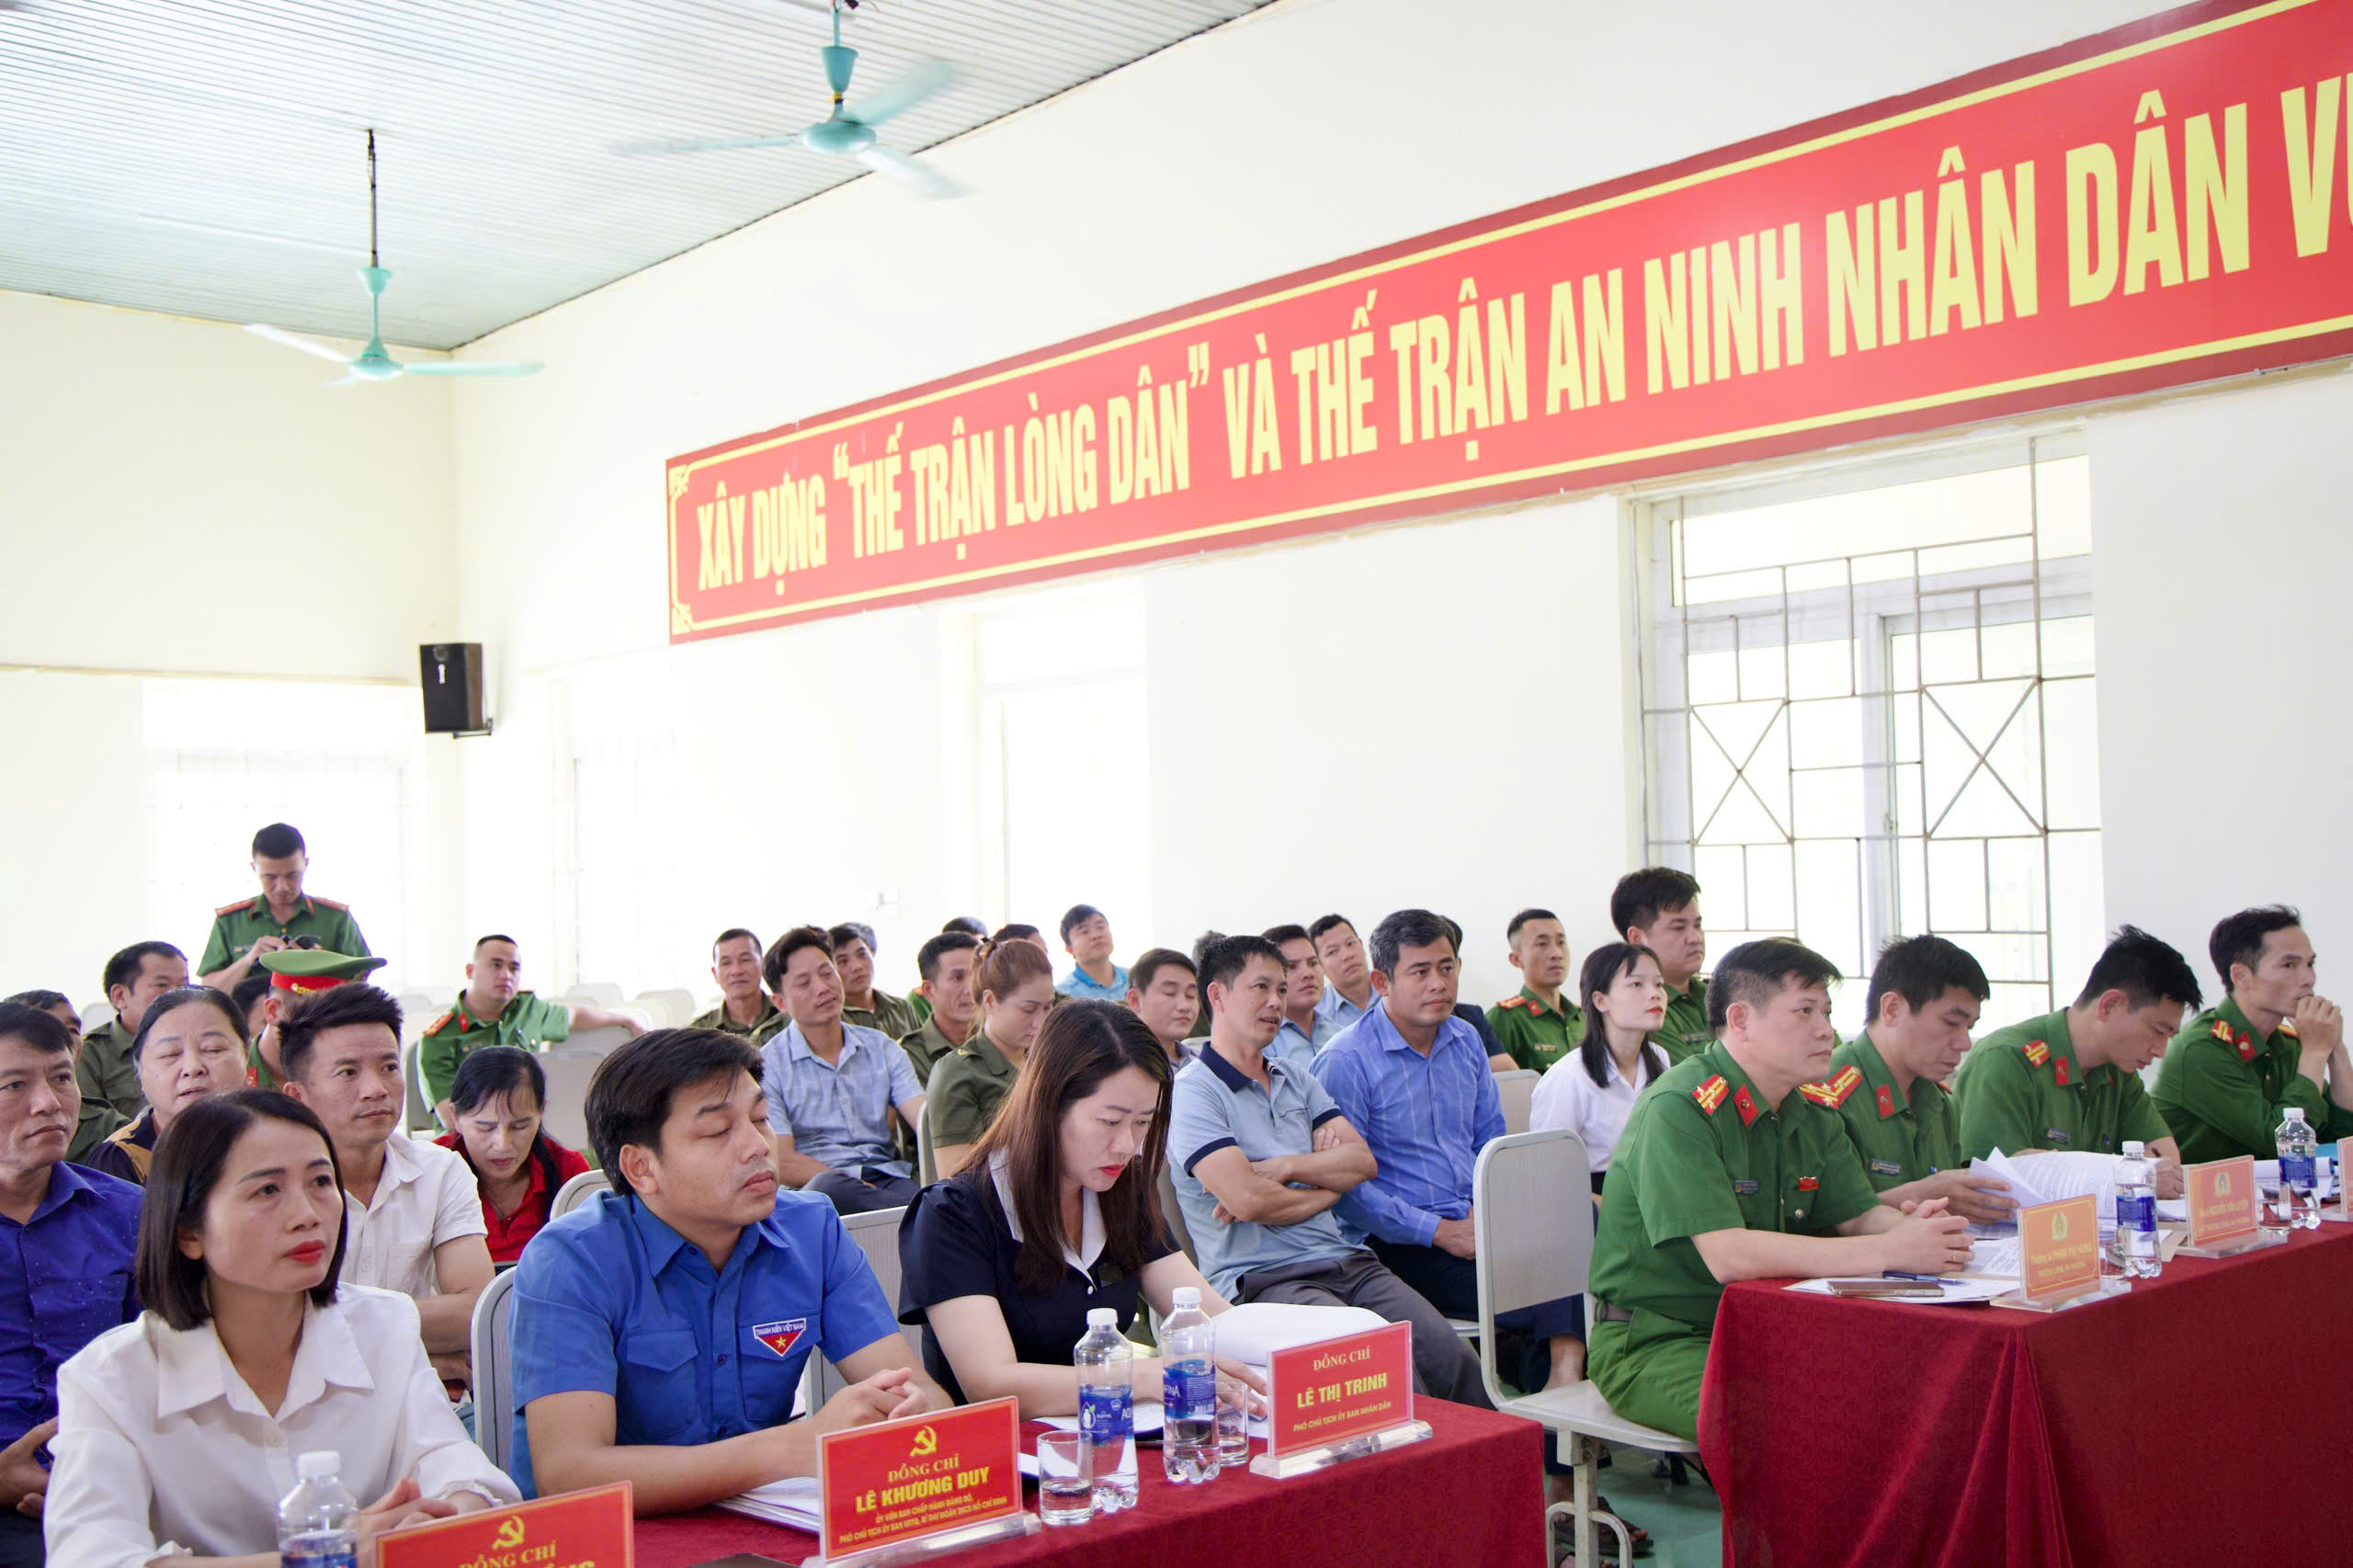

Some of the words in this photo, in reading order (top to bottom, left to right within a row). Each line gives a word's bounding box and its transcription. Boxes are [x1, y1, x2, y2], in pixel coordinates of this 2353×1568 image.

[697, 481, 745, 591] XÂY
[752, 469, 827, 596] DỰNG
[910, 416, 996, 561] TRẬN
[1005, 392, 1098, 527] LÒNG
[1222, 333, 1283, 480] VÀ
[1290, 289, 1378, 466] THẾ
[1389, 277, 1529, 461] TRẬN
[1545, 267, 1626, 416] AN
[1643, 222, 1804, 395] NINH
[1825, 145, 2039, 358] NHÂN
[2065, 89, 2250, 308] DÂN
[2280, 70, 2353, 258] V
[782, 1322, 793, 1333] VIỆT
[793, 1322, 804, 1331] NAM
[1313, 1353, 1347, 1370] ĐỒNG
[1349, 1346, 1370, 1361] CHÍ
[1297, 1387, 1314, 1408] LÊ
[1319, 1383, 1340, 1402] THỊ
[1345, 1372, 1387, 1395] TRINH
[1294, 1421, 1307, 1432] PHÓ
[1308, 1416, 1322, 1428] CHỦ
[1324, 1415, 1336, 1426] TỊCH
[1347, 1410, 1359, 1419] BAN
[1360, 1404, 1377, 1415] NHÂN
[1378, 1401, 1392, 1412] DÂN
[888, 1462, 930, 1482] ĐỒNG
[933, 1453, 960, 1471] CHÍ
[856, 1489, 877, 1513] LÊ
[881, 1475, 953, 1507] KHƯƠNG
[957, 1466, 990, 1489] DUY
[521, 1539, 556, 1563] CHÍ
